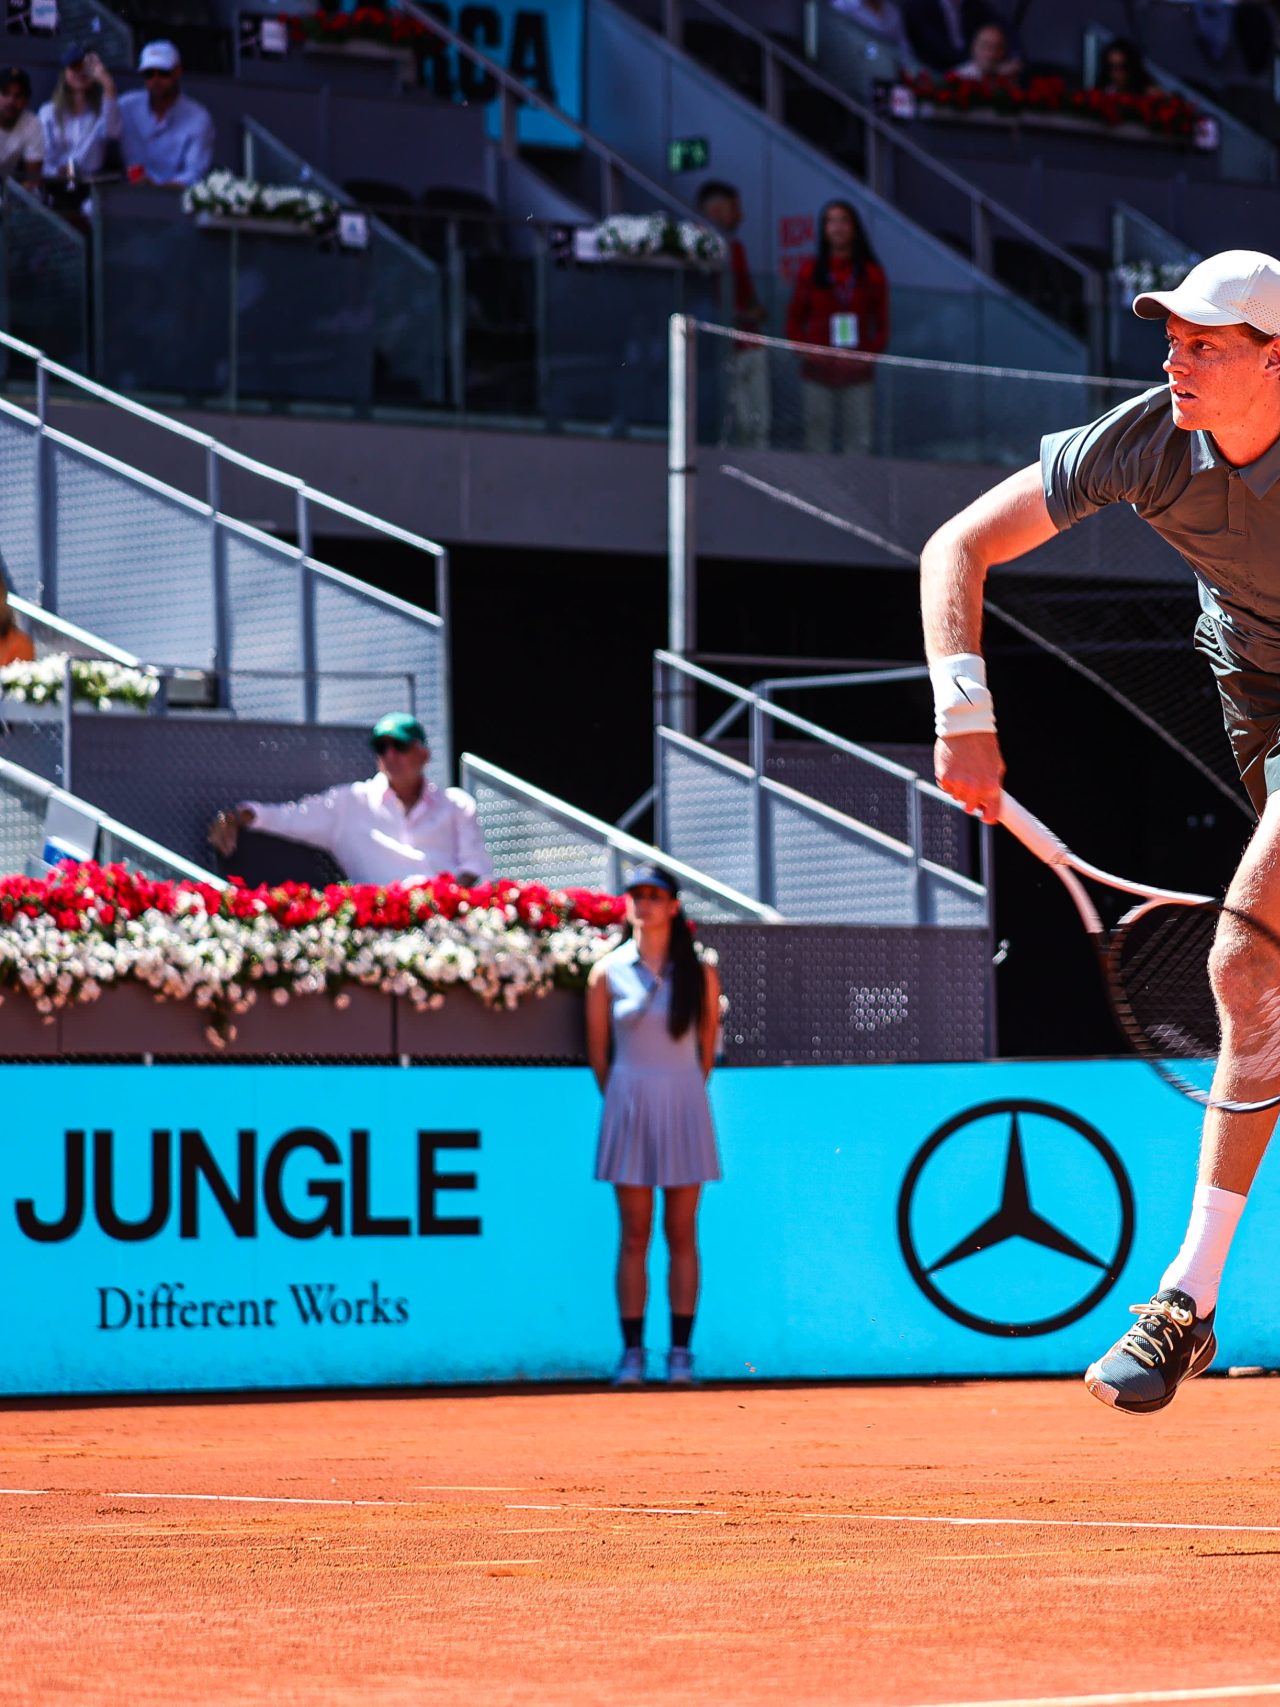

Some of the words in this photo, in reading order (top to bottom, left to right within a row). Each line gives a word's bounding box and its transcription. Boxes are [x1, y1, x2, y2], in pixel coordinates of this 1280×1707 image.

[15, 1126, 481, 1242] JUNGLE
[97, 1283, 277, 1329] Different
[289, 1281, 408, 1326] Works
